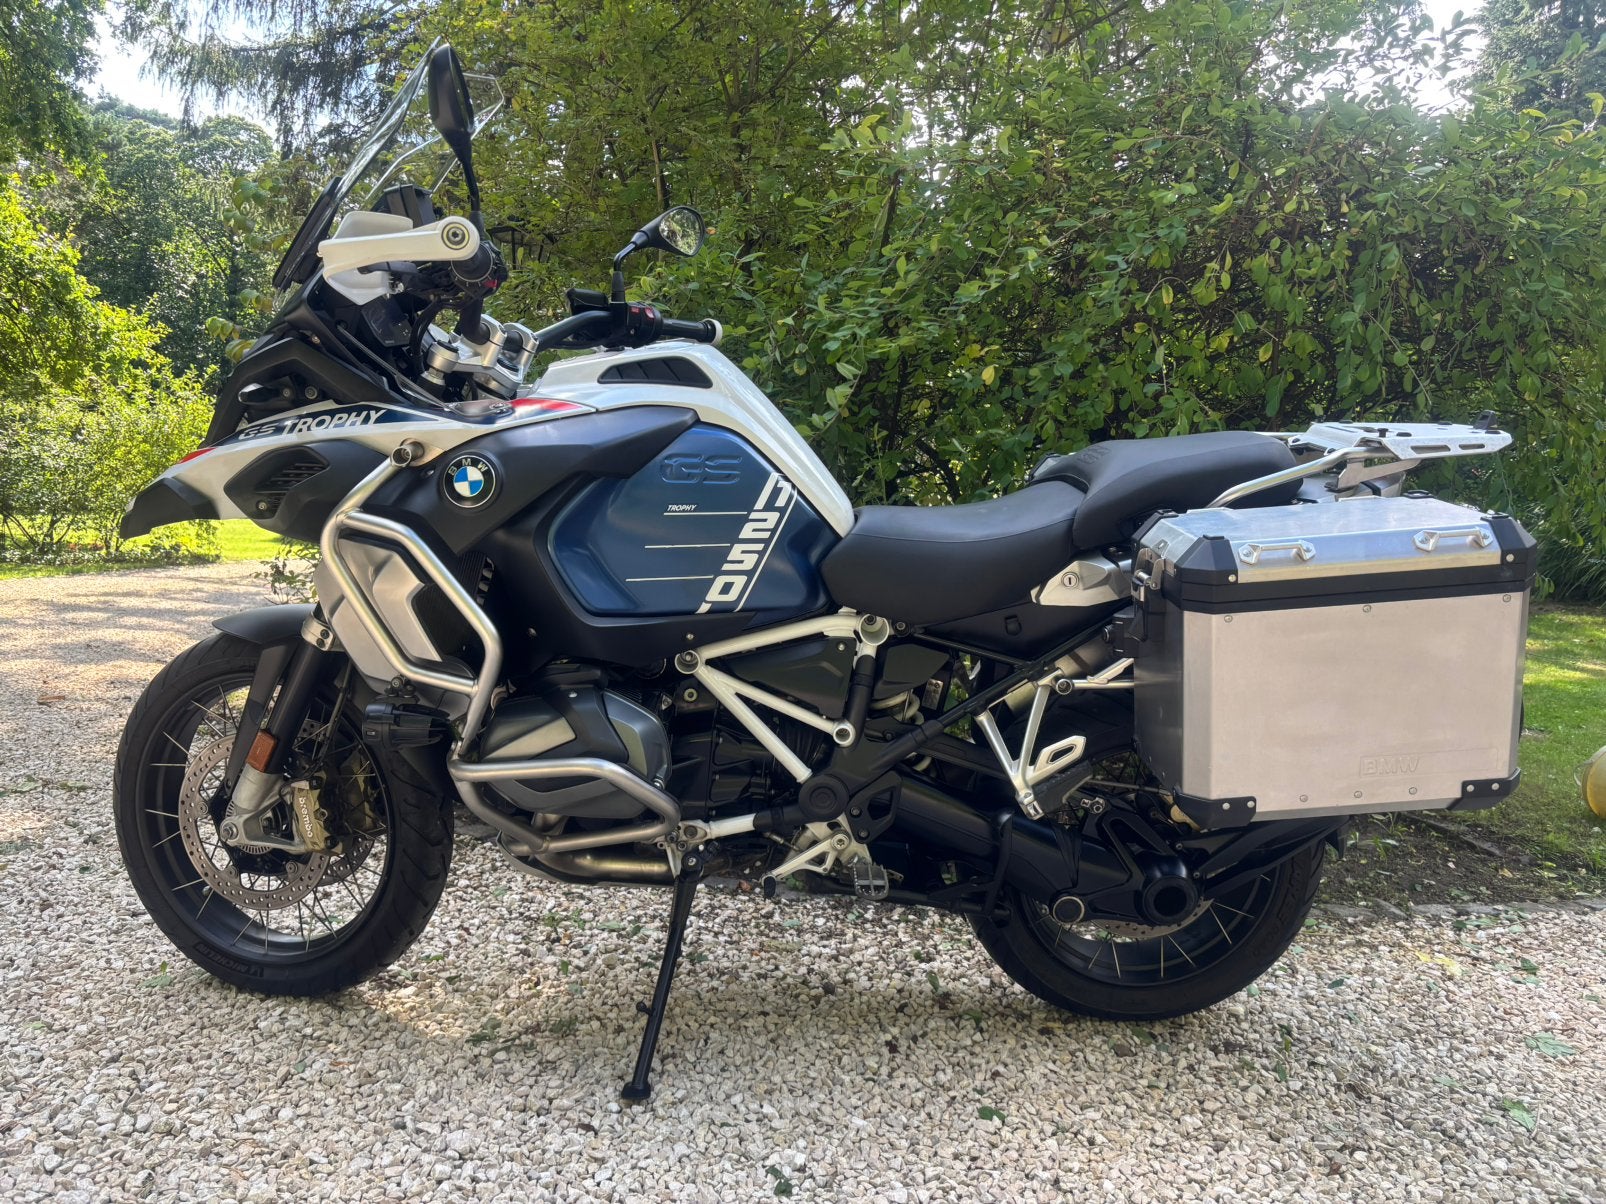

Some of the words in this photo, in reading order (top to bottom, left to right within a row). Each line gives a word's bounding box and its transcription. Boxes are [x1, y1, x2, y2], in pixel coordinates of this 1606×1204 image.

[238, 423, 279, 440] GS
[282, 409, 388, 436] TROPHY
[448, 458, 489, 476] BMW
[660, 453, 742, 484] GS
[667, 504, 697, 512] TROPHY
[705, 480, 793, 602] 1250
[1362, 755, 1420, 776] BMW
[298, 796, 313, 839] brembo
